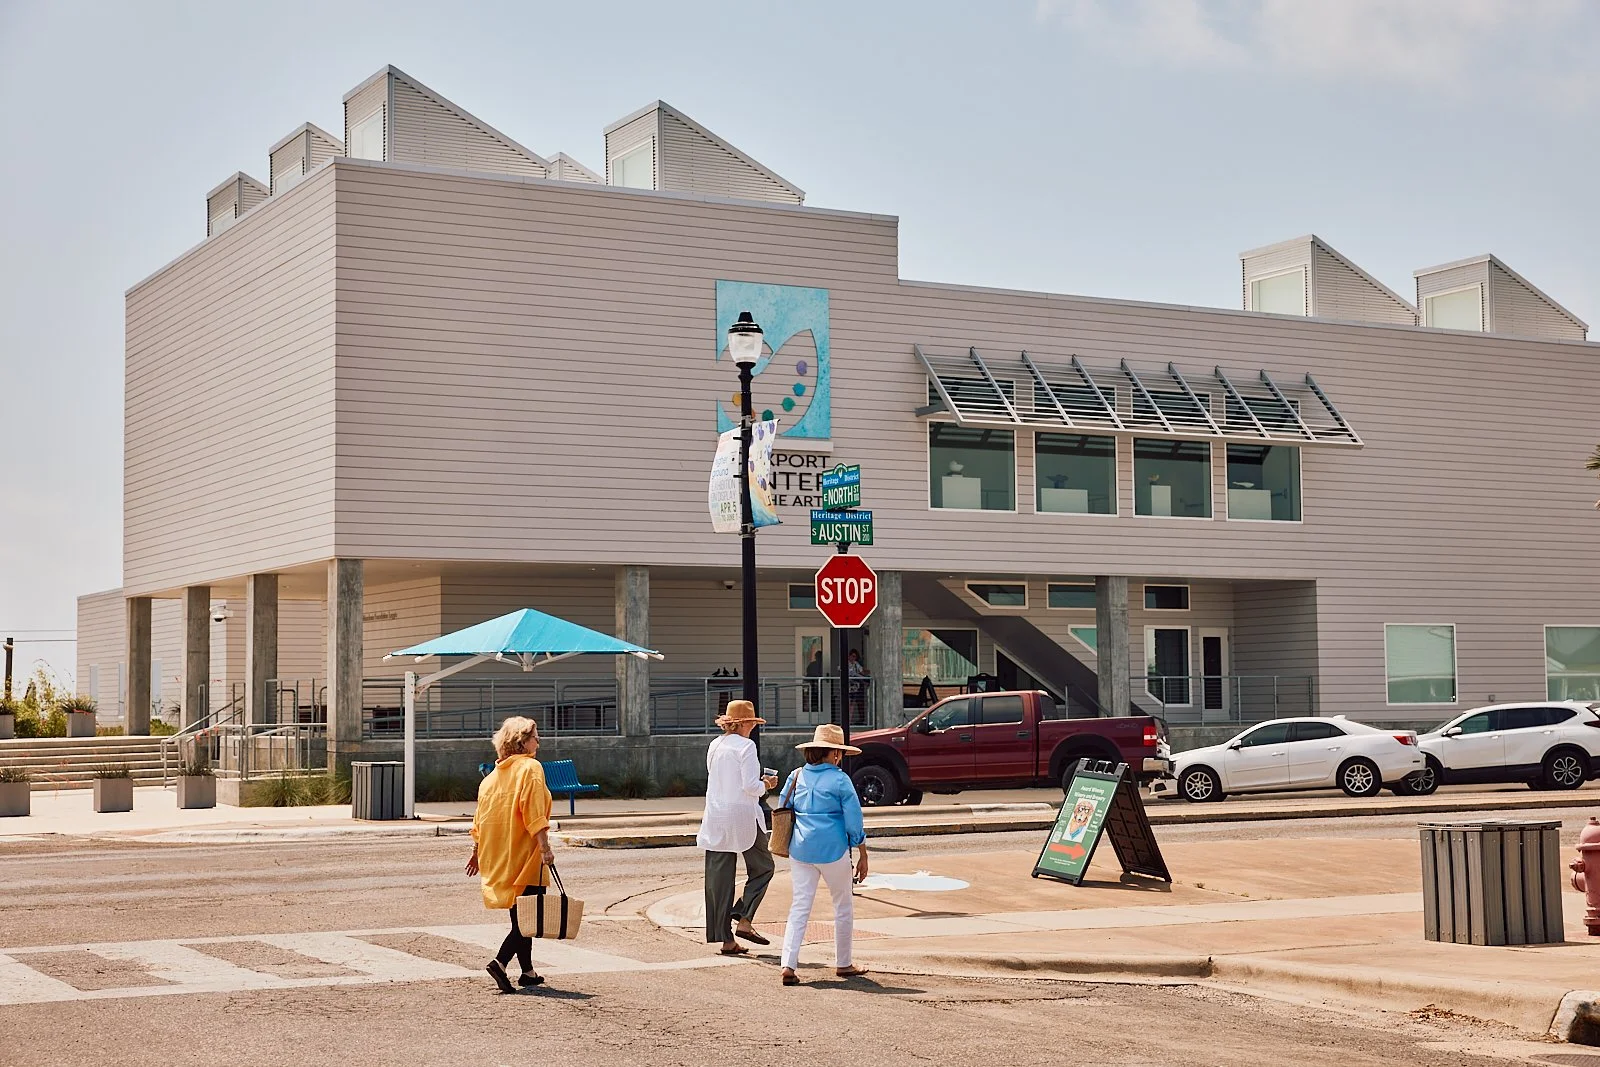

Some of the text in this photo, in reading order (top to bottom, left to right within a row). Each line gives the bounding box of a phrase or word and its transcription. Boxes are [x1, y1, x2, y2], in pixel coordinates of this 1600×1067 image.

[823, 477, 839, 485] Heritage
[823, 484, 859, 505] E NORTH ST
[720, 501, 737, 513] APR 5
[812, 511, 871, 520] Heritage District
[812, 528, 817, 536] S
[818, 524, 861, 541] AUSTIN
[820, 578, 873, 604] STOP
